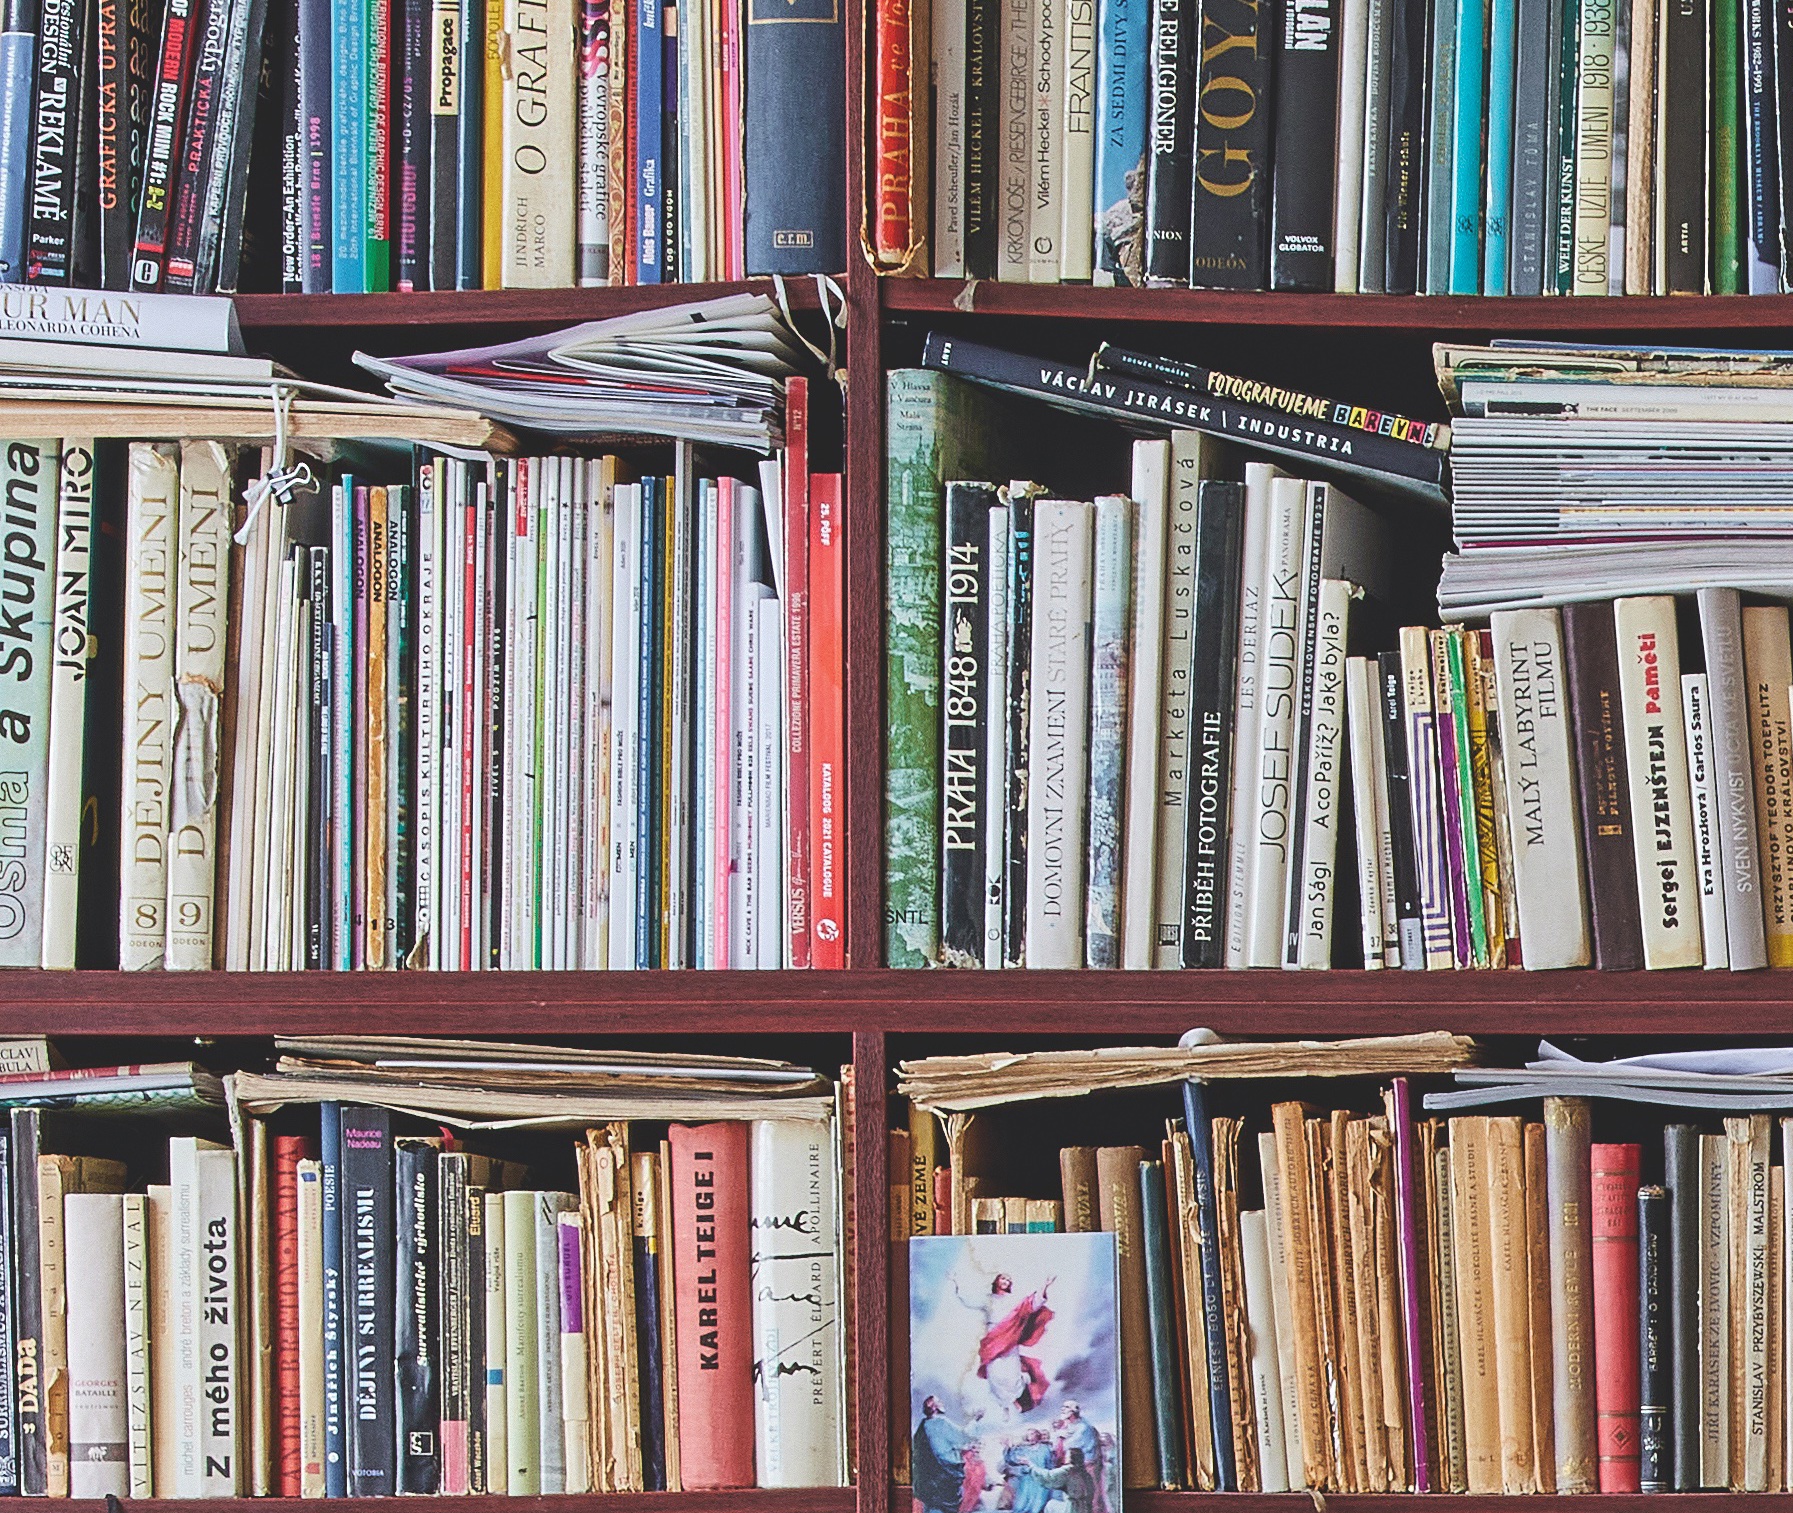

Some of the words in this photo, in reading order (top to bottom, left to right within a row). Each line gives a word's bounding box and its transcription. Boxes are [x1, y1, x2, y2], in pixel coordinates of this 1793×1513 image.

[41, 2, 58, 74] DESIGN
[163, 19, 184, 80] MODERN
[440, 19, 456, 107] Propagace
[1038, 33, 1053, 93] Schody
[1113, 15, 1127, 57] DIVY
[158, 83, 177, 120] ROCK
[1111, 62, 1125, 119] SEDMI
[1155, 20, 1178, 153] RELIGIONER
[34, 91, 68, 220] REKLAMĚ
[154, 124, 171, 158] MINI
[188, 77, 212, 172] PRAKTICKÁ
[882, 89, 908, 221] PRAHA
[971, 108, 982, 174] HECKEL
[1037, 108, 1050, 162] Heckel
[1110, 126, 1124, 147] ZA
[644, 159, 656, 197] Grafika
[1037, 165, 1050, 209] Vilém
[1562, 156, 1572, 203] KUNST
[32, 233, 64, 246] Parker
[535, 214, 545, 268] MARCO
[1561, 206, 1572, 234] DER
[1559, 236, 1570, 273] WELT
[63, 295, 141, 325] MAN
[81, 322, 141, 339] COHENA
[1124, 387, 1210, 422] JIRÁSEK
[1238, 416, 1352, 454] INDUSTRIA
[1207, 372, 1331, 420] FOTOGRAFUJEME
[180, 486, 219, 651] UMĚNÍ
[388, 521, 398, 600] ANALOGON
[948, 542, 978, 602] 1914
[1168, 458, 1195, 640] Luskačová
[56, 571, 87, 680] JOAN
[422, 552, 433, 634] OKRAJE
[1265, 570, 1298, 718] SUDEK
[1322, 612, 1342, 666] byla?
[948, 656, 976, 728] 1848
[1319, 671, 1340, 715] Jaká
[1510, 642, 1537, 768] LABYRINT
[1534, 641, 1556, 718] FILMU
[1637, 633, 1661, 714] Paměti
[0, 710, 30, 744] a
[1162, 670, 1186, 806] Markéta
[1689, 687, 1701, 731] Saura
[128, 681, 163, 866] DĚJINY
[1198, 712, 1222, 855] FOTOGRAFIE
[1316, 723, 1338, 782] Paříž?
[1692, 735, 1704, 782] Carlos
[1775, 721, 1792, 817] KRÁLOVSTVÍ
[948, 748, 976, 850] PRAHA
[1260, 730, 1289, 863] JOSEF
[1520, 775, 1544, 846] MALÝ
[1646, 725, 1672, 851] EJZENŠTEJN
[1697, 793, 1710, 865] Hrozková
[180, 903, 201, 926] 9
[1193, 862, 1214, 941] PŘÍBĚH
[1308, 861, 1331, 901] Ságl
[1656, 860, 1679, 928] Sergej
[1703, 868, 1713, 895] Eva
[136, 904, 157, 928] 8
[1308, 906, 1326, 939] Jan
[695, 1171, 716, 1263] TEIGE
[809, 1144, 820, 1245] APOLLINAIRE
[203, 1216, 228, 1325] života
[356, 1188, 375, 1334] SURREALISMU
[698, 1269, 719, 1370] KAREL
[204, 1343, 230, 1436] mého
[358, 1345, 376, 1420] DĚJINY
[206, 1455, 230, 1478] Z
